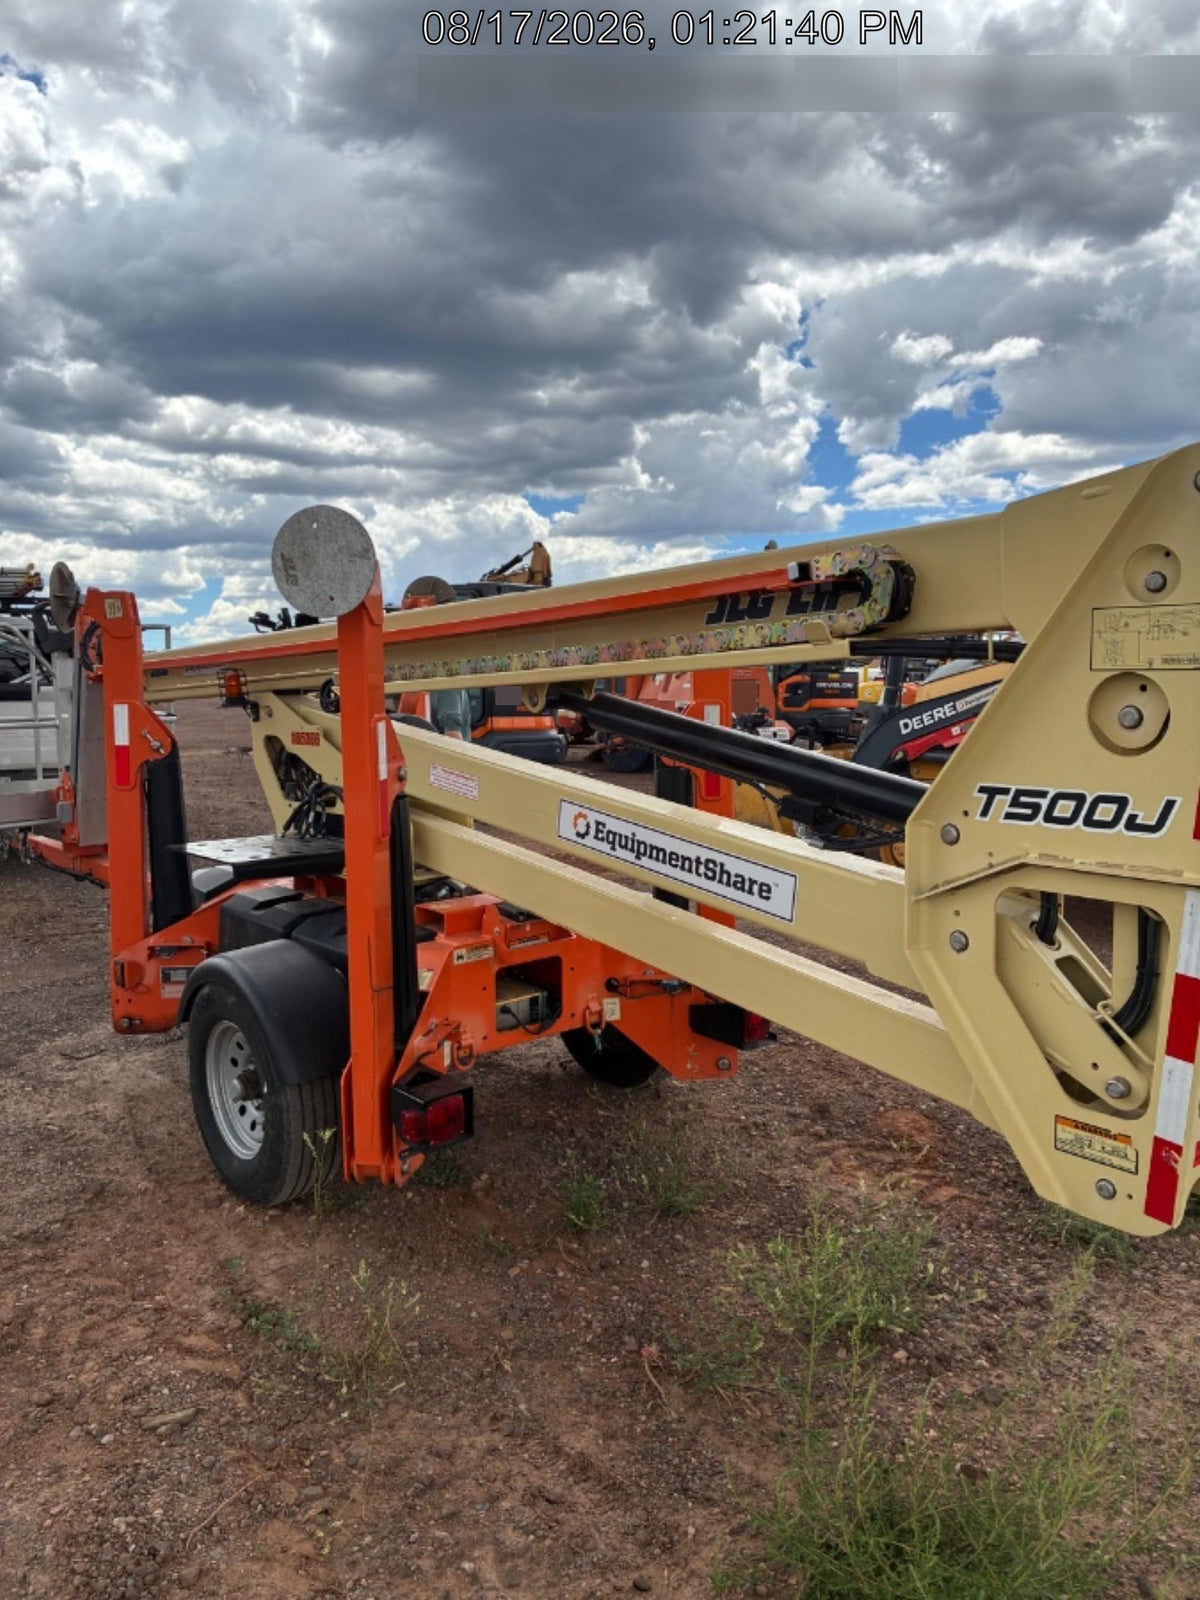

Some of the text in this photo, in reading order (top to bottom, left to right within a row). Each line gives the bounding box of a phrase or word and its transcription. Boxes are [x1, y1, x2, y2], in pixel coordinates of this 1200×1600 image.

[899, 702, 957, 735] DEERE
[974, 783, 1181, 837] T500J
[593, 819, 773, 902] EquipmentShare
